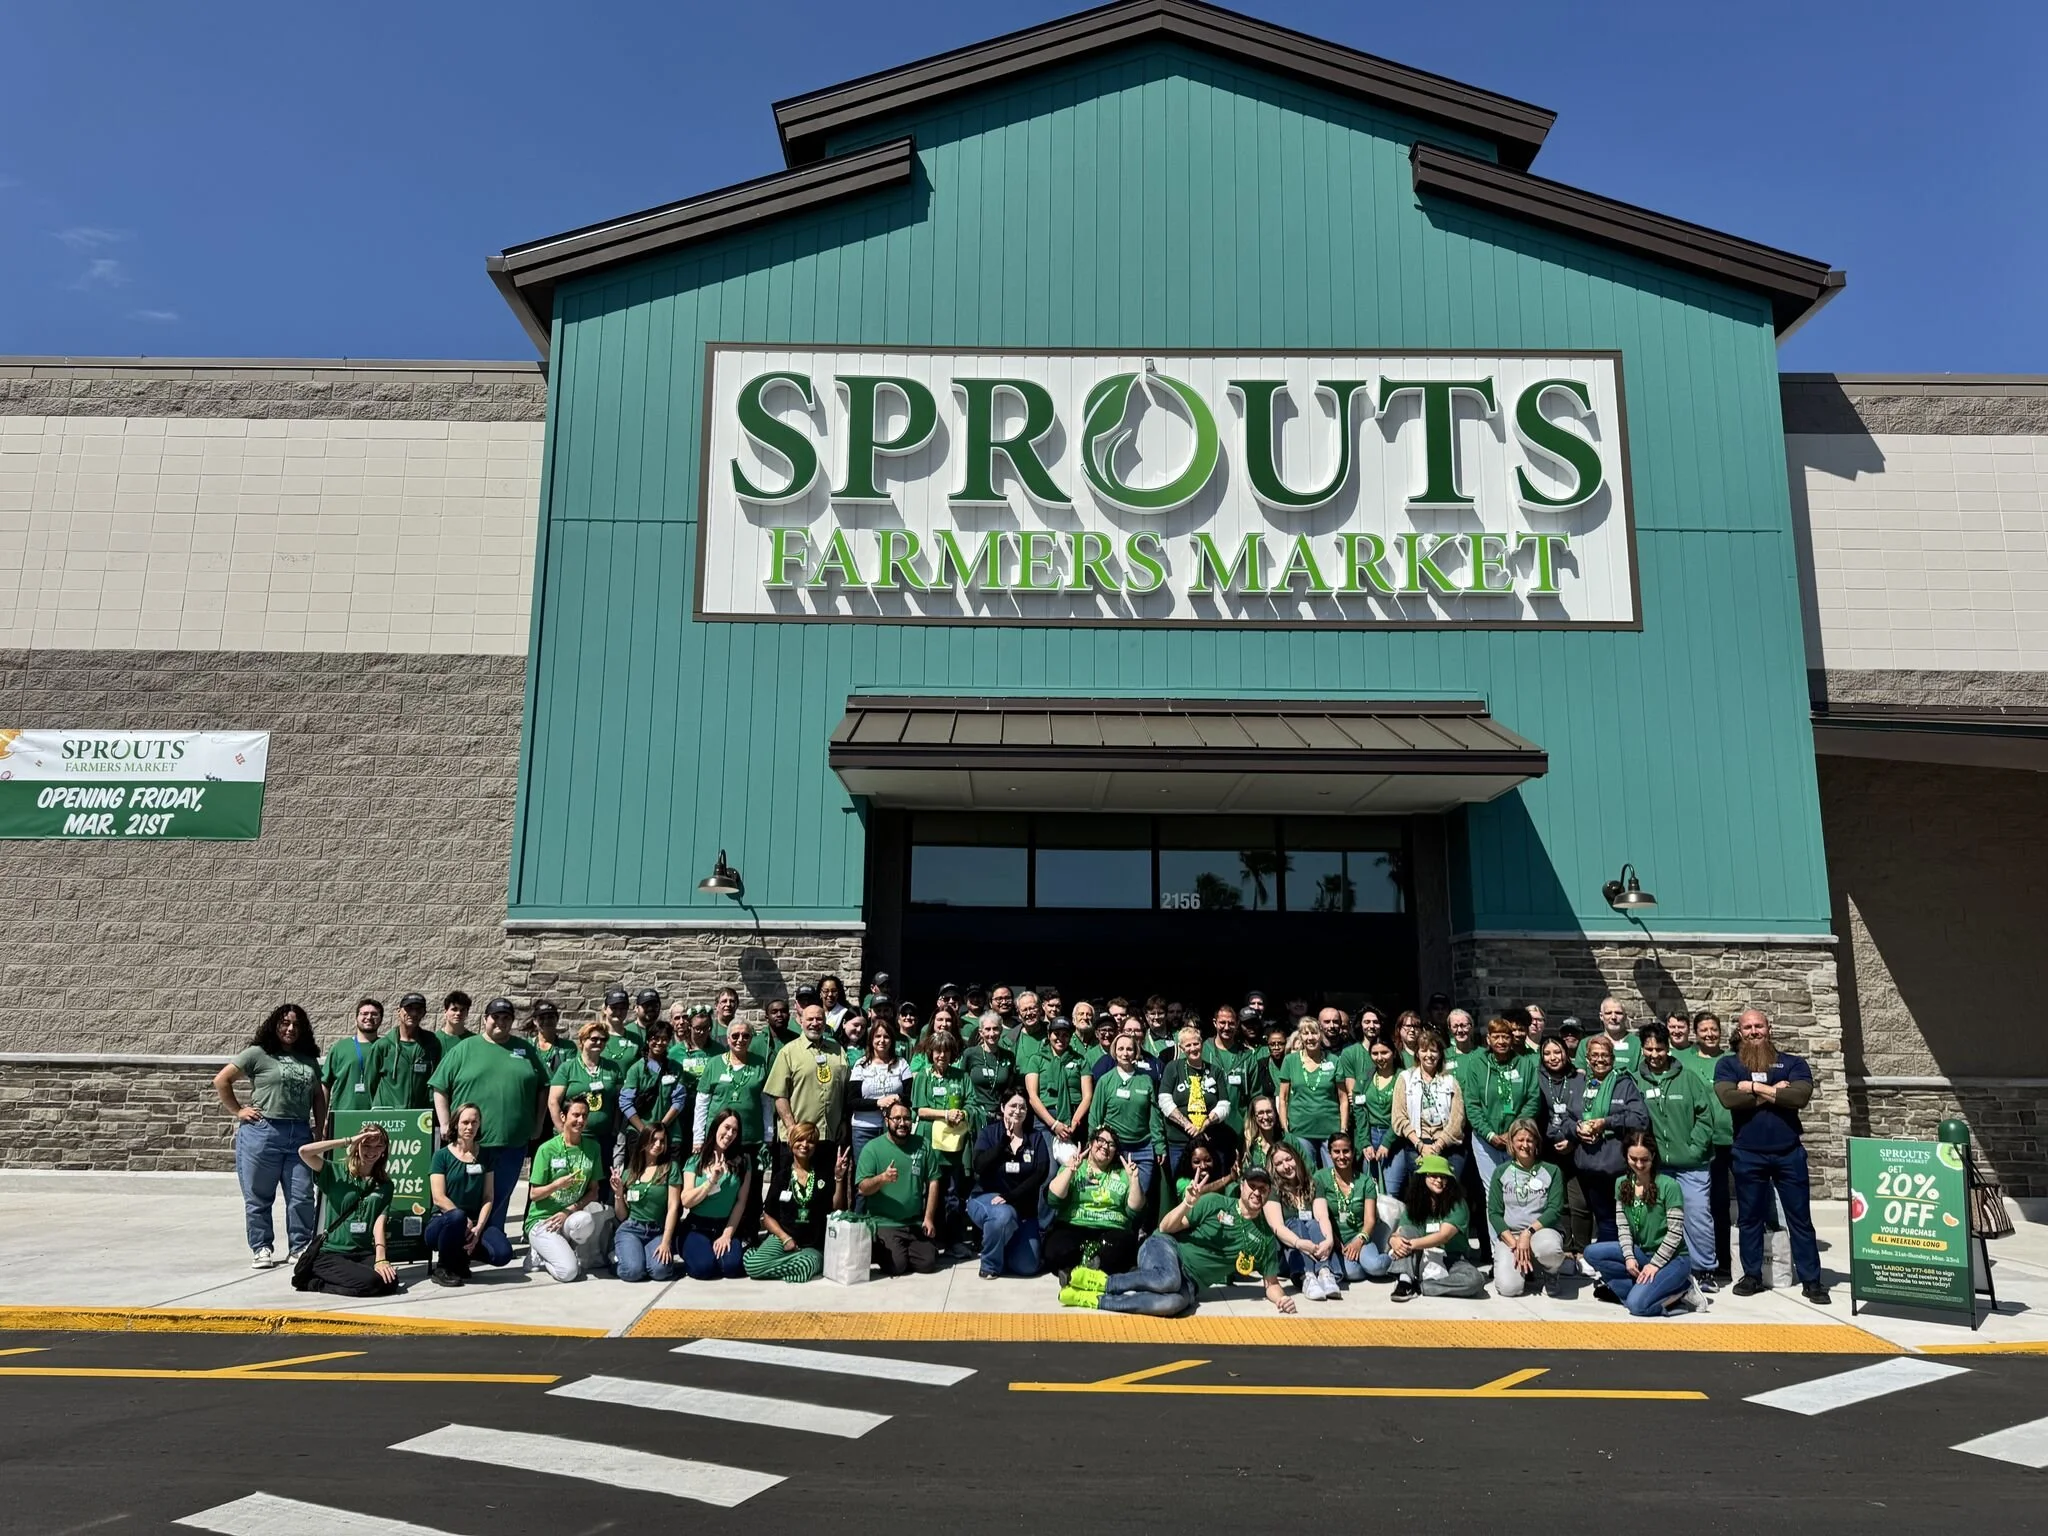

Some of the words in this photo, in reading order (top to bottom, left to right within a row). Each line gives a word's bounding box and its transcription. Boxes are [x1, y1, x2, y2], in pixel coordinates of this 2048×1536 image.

[729, 369, 1607, 514] SPROUTS
[762, 525, 1169, 597] FARMERS
[1187, 530, 1575, 599] MARKET
[61, 739, 185, 760] SPROUTS
[64, 762, 122, 773] FARMERS
[123, 762, 178, 773] MARKET
[37, 786, 126, 810] OPENING
[128, 787, 206, 812] FRIDAY,
[62, 813, 117, 835] MAR.
[124, 813, 175, 836] 21ST
[1160, 892, 1201, 910] 2156
[1879, 1148, 1931, 1160] SPROUTS
[1887, 1165, 1904, 1174] GET
[1876, 1171, 1940, 1200] 20%
[1880, 1225, 1899, 1234] YOUR
[1900, 1227, 1937, 1238] PURCHASE
[1877, 1235, 1888, 1243] ALL
[1890, 1237, 1921, 1246] WEEKEND
[1922, 1240, 1941, 1248] LONG
